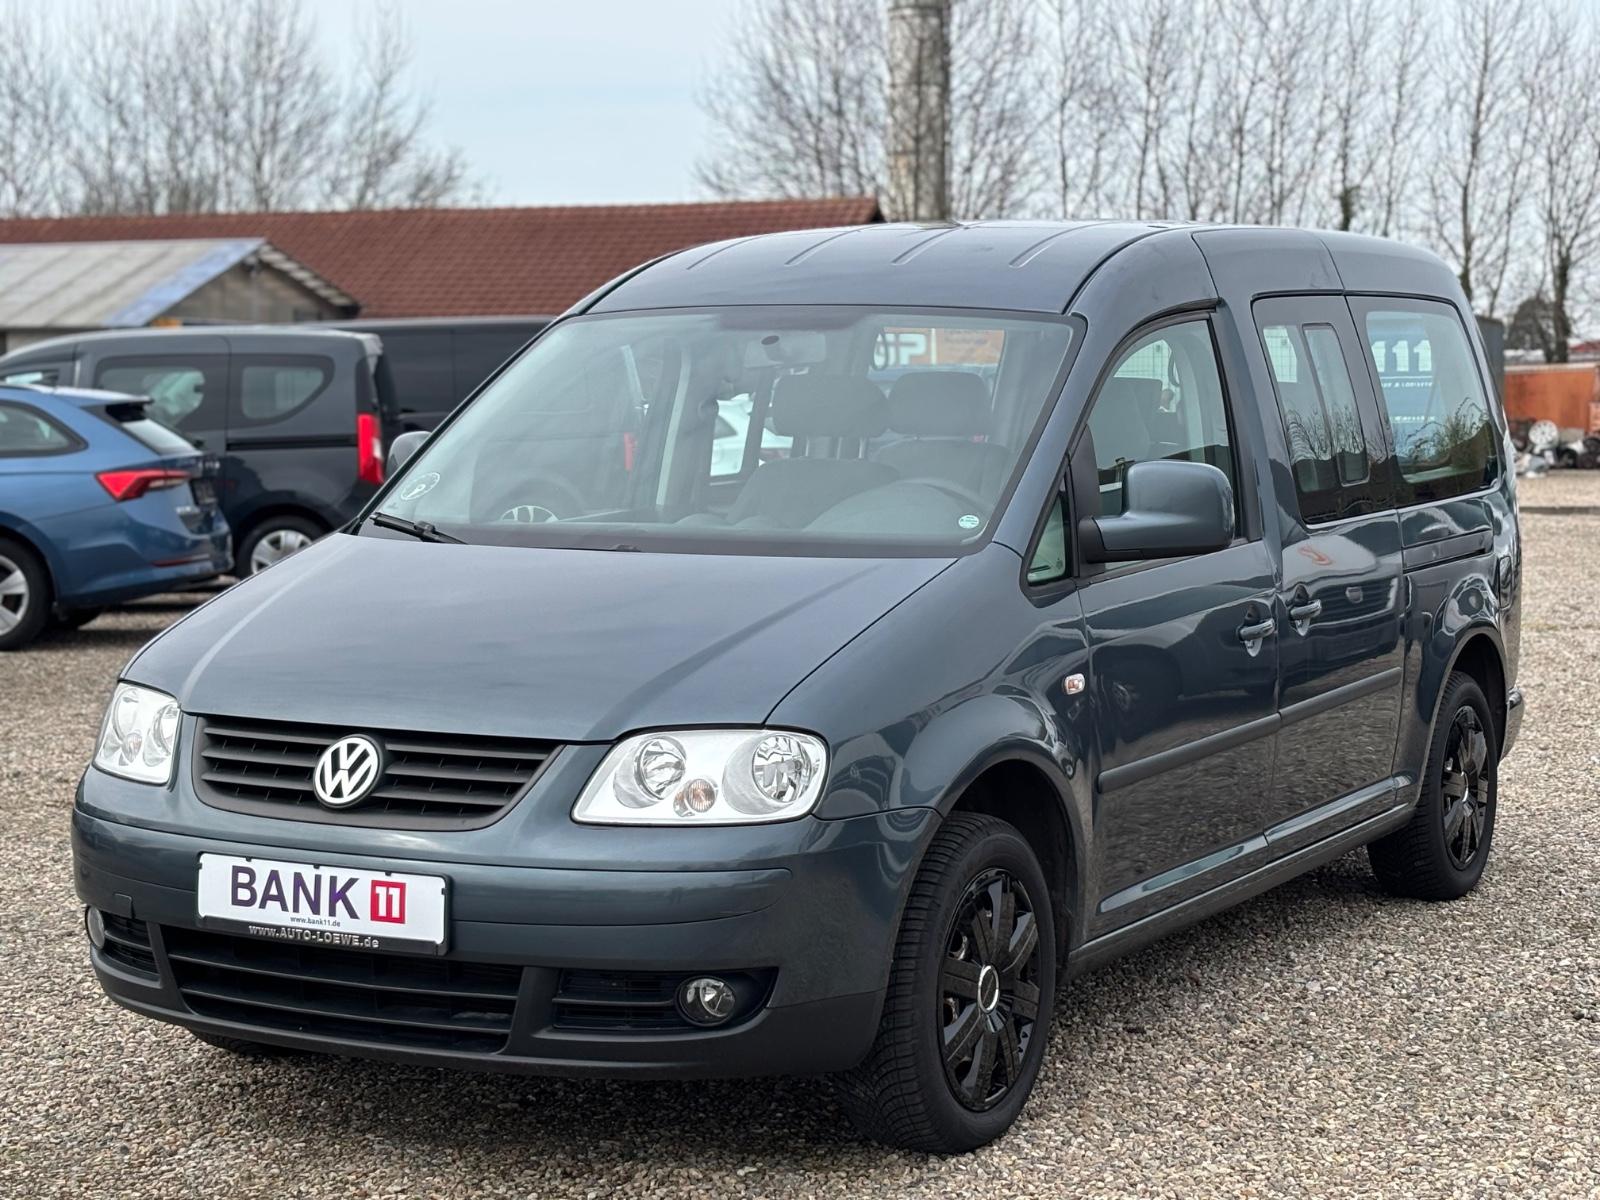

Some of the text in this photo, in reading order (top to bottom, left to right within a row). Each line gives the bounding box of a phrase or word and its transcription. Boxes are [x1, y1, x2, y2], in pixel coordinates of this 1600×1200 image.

[231, 865, 402, 920] BANK 11
[289, 915, 341, 928] www.bank11.de
[249, 925, 380, 949] www.AUTO-LOEWE.de
